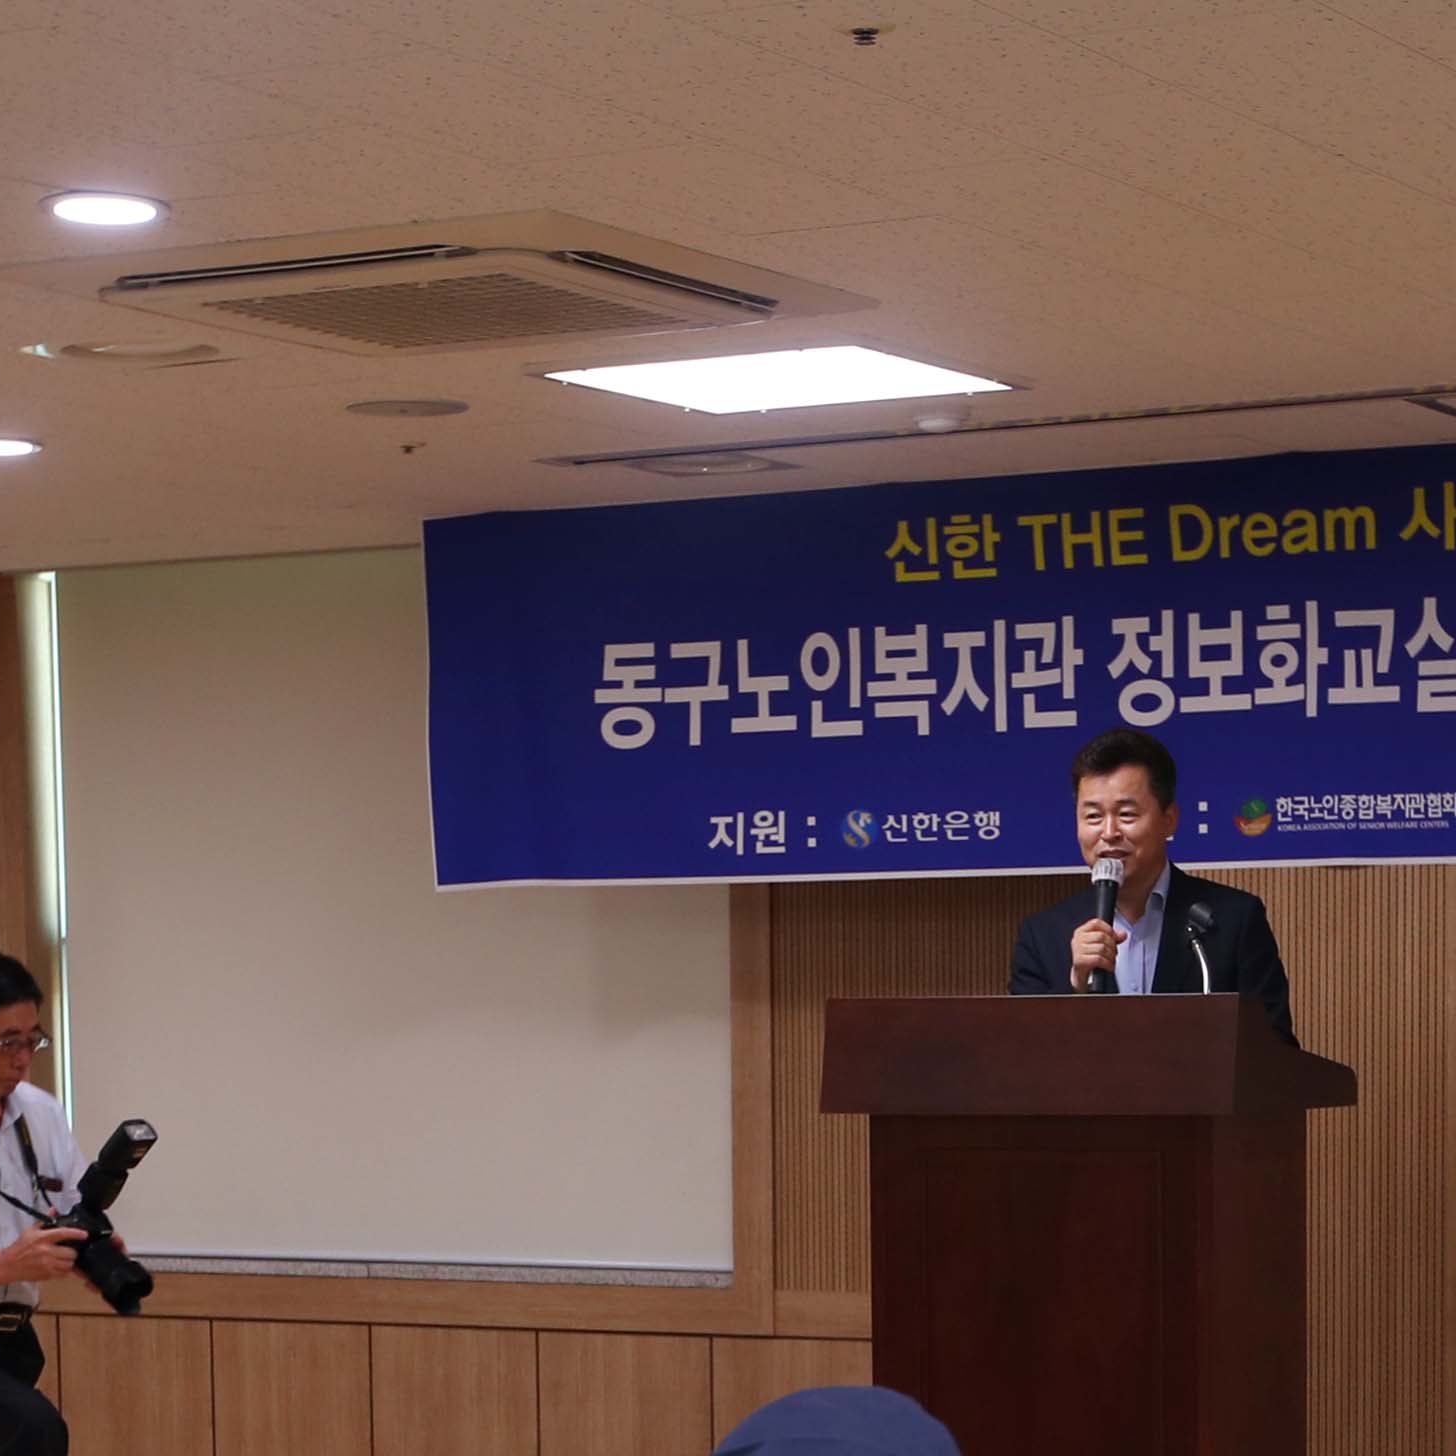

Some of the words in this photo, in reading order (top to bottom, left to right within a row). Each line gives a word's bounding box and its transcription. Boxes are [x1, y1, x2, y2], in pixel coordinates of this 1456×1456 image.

[885, 514, 1001, 583] 신한
[1017, 507, 1149, 571] THE
[1169, 504, 1377, 562] Dream
[594, 615, 1084, 750] 동구노인복지관
[708, 810, 787, 856] 지원
[882, 810, 1001, 842] 신한은행
